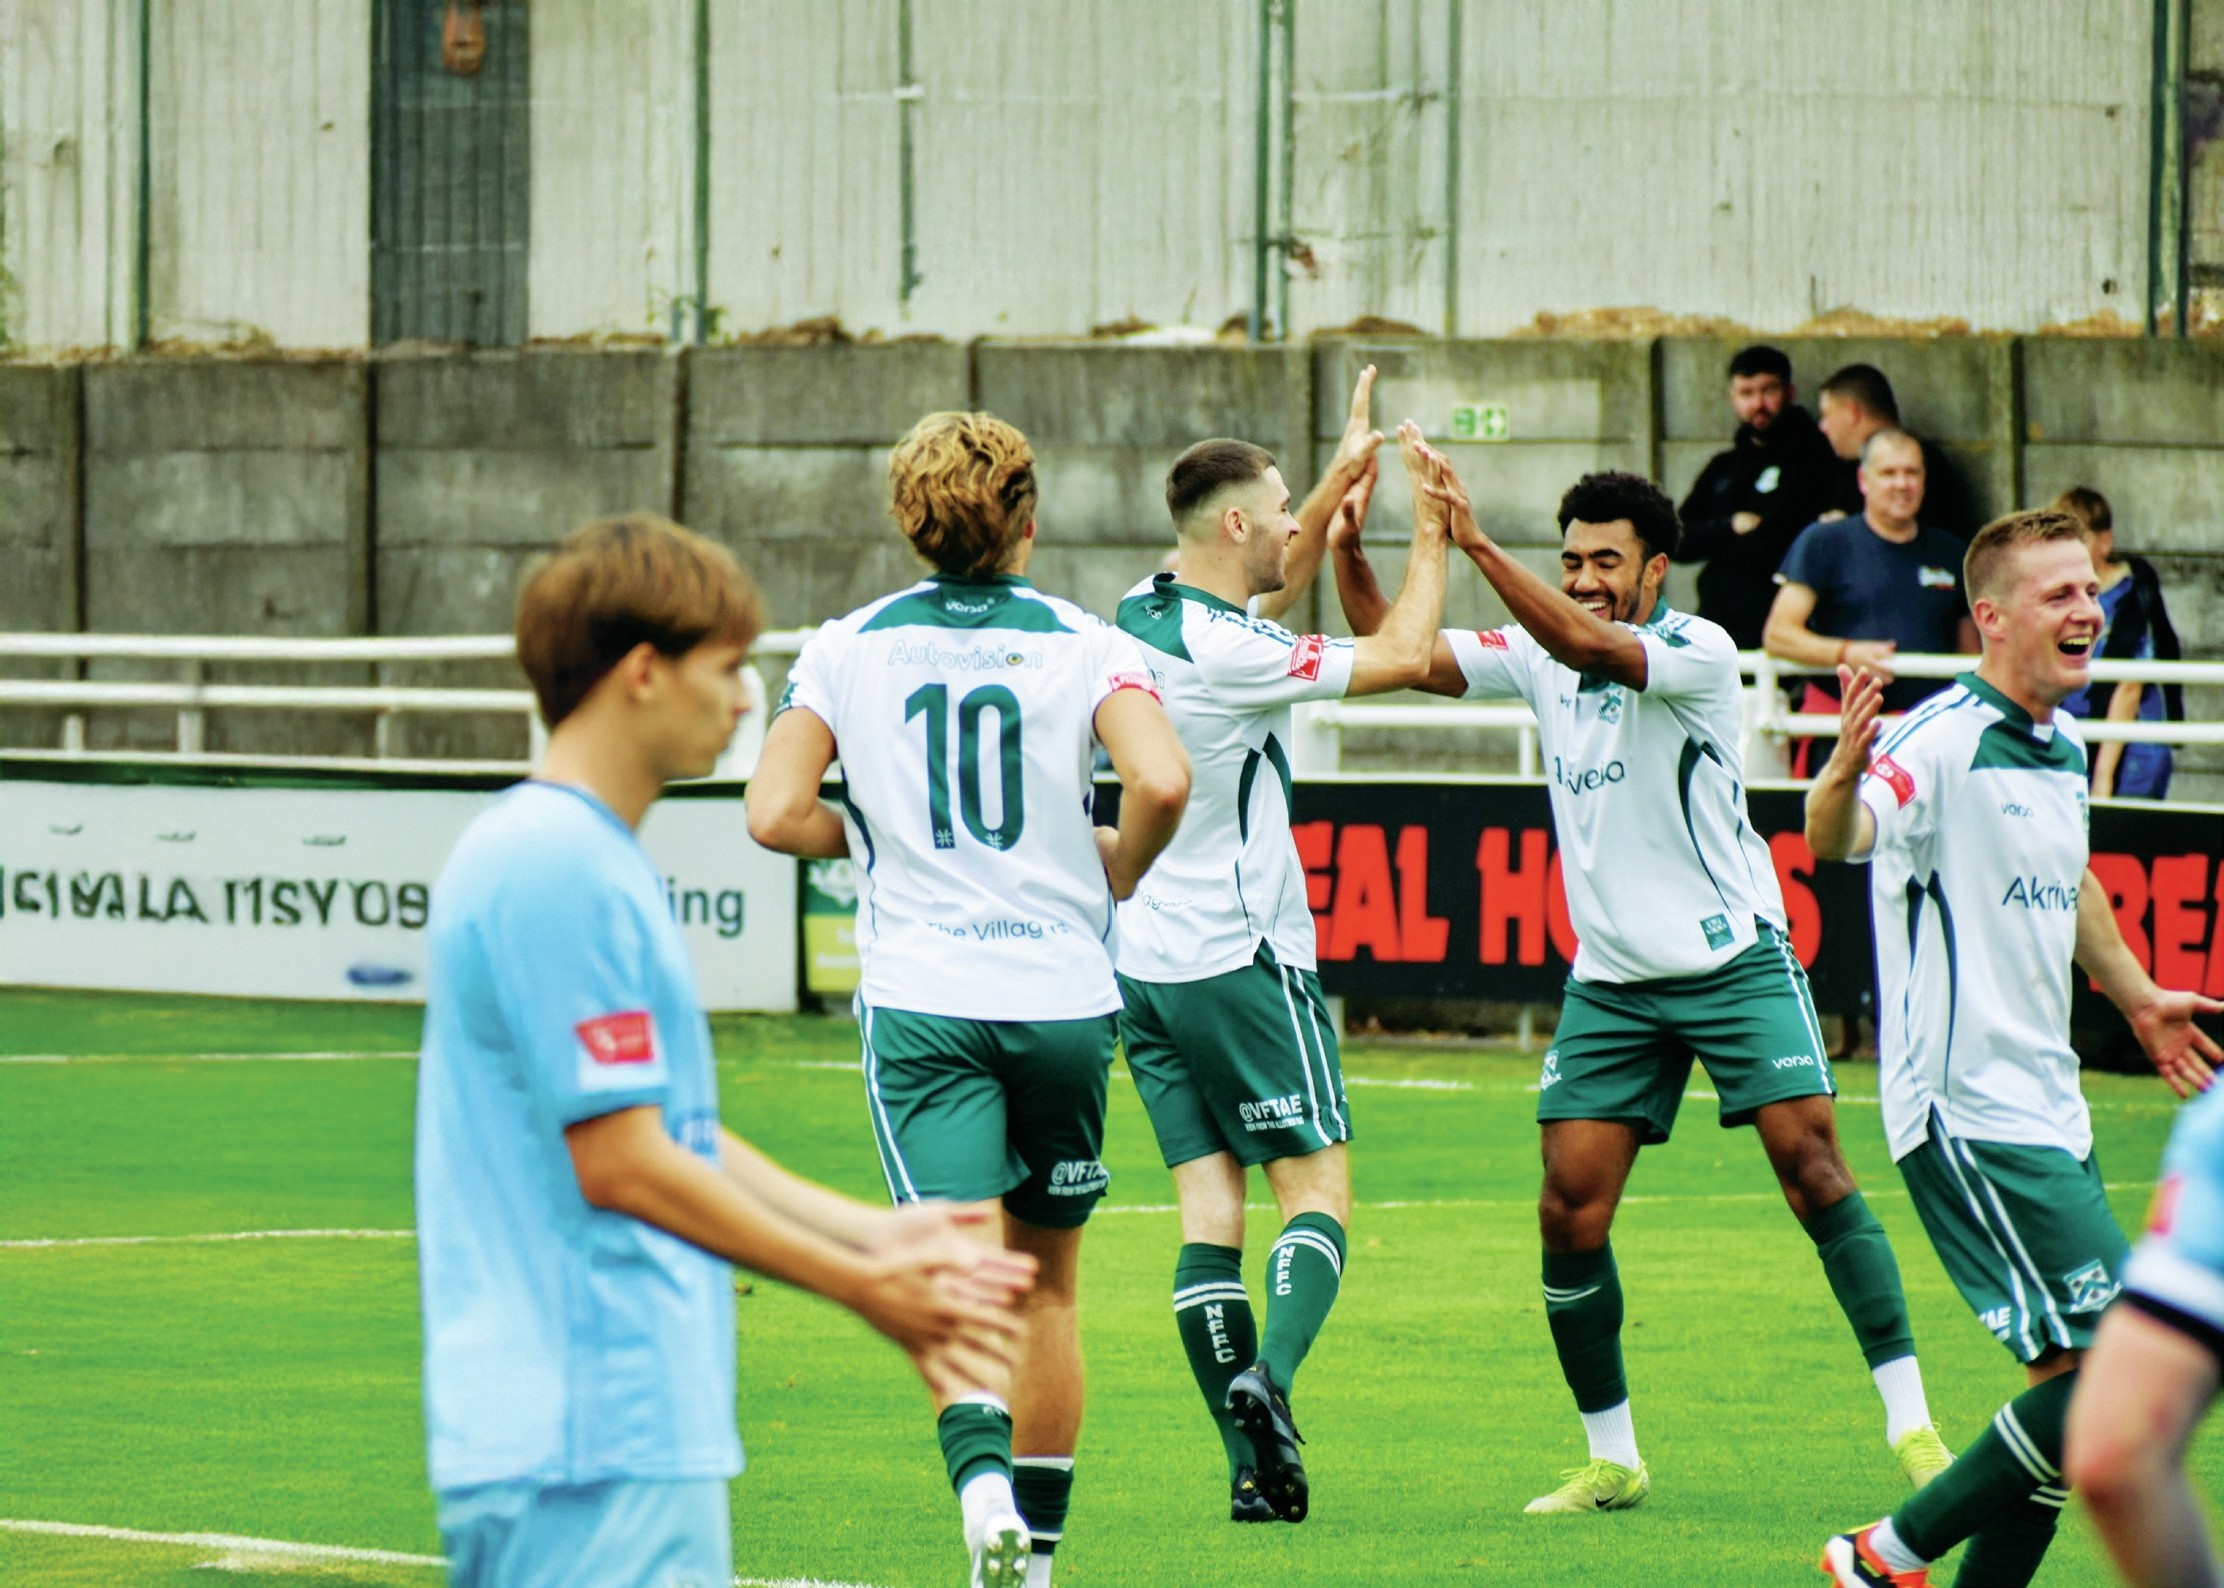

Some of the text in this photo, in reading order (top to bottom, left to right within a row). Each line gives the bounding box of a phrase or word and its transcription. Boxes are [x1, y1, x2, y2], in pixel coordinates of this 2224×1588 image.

[887, 639, 1044, 671] Autovision
[904, 683, 1024, 852] 10
[1239, 1093, 1303, 1123] @VFTAE
[1275, 1245, 1296, 1296] NFFC
[1204, 1303, 1237, 1365] NFFC
